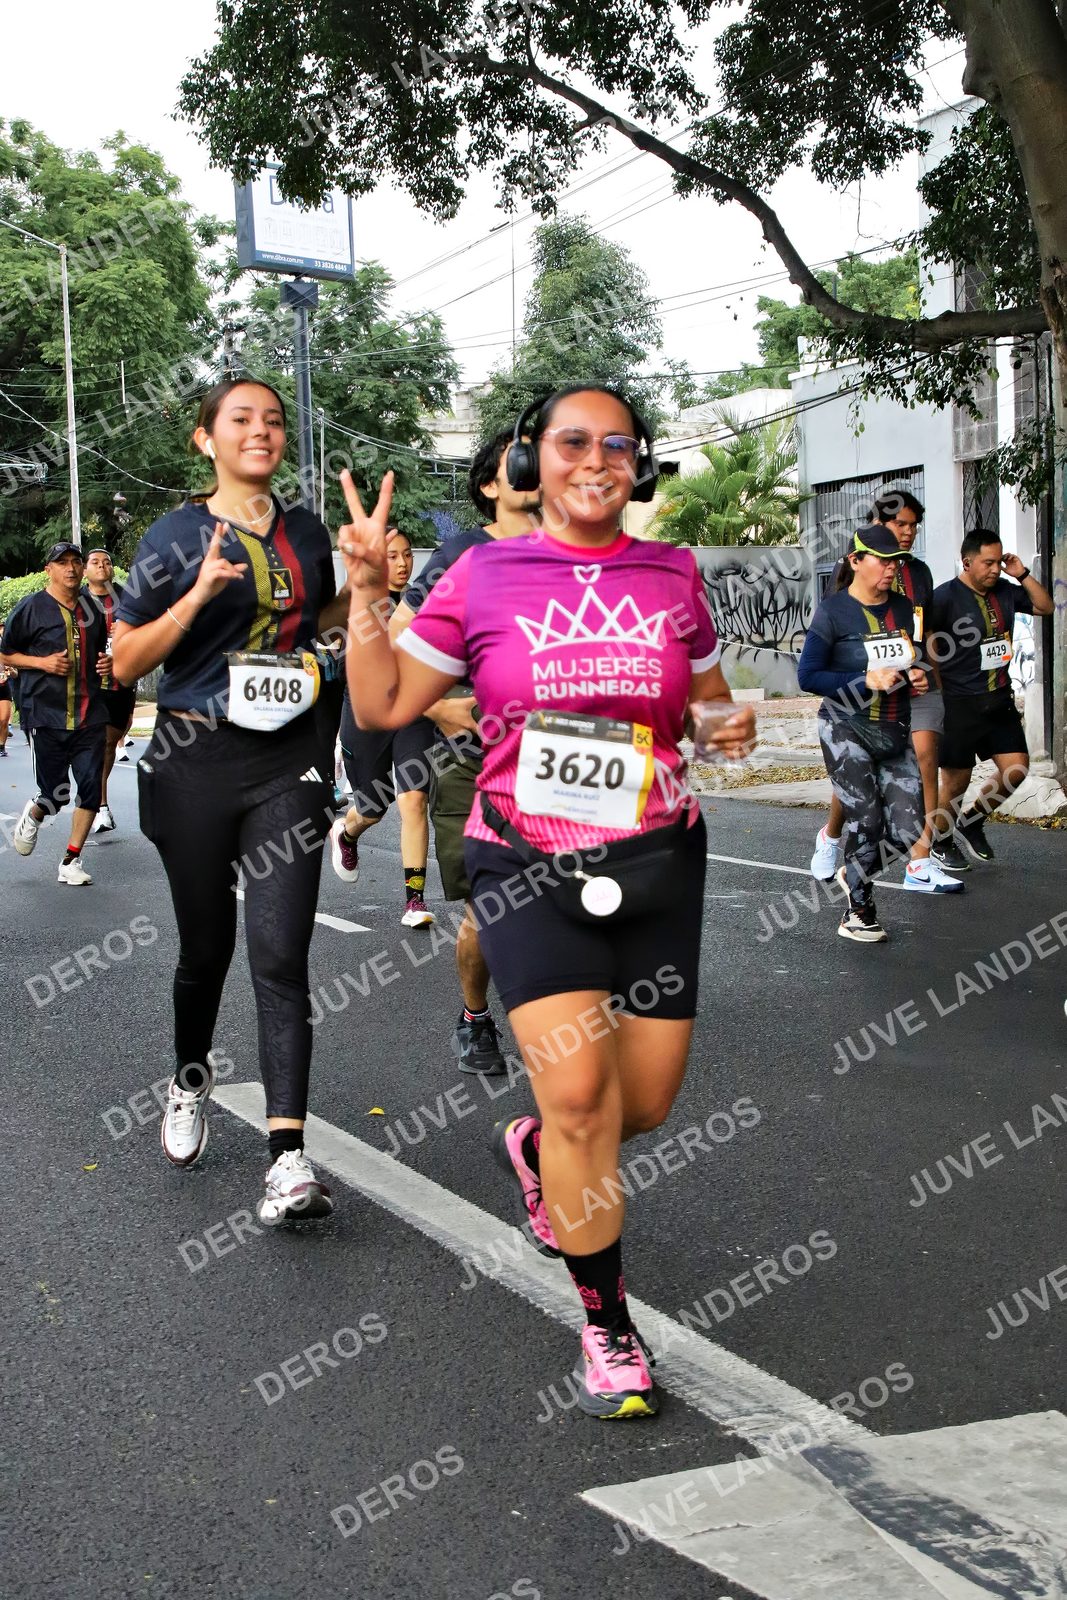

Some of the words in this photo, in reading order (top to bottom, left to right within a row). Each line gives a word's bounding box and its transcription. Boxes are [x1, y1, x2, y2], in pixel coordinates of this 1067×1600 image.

[873, 643, 904, 659] 1733
[986, 644, 1007, 658] 4429
[532, 657, 662, 681] MUJERES
[243, 675, 302, 704] 6408
[534, 679, 662, 701] RUNNERAS
[535, 747, 625, 790] 3620
